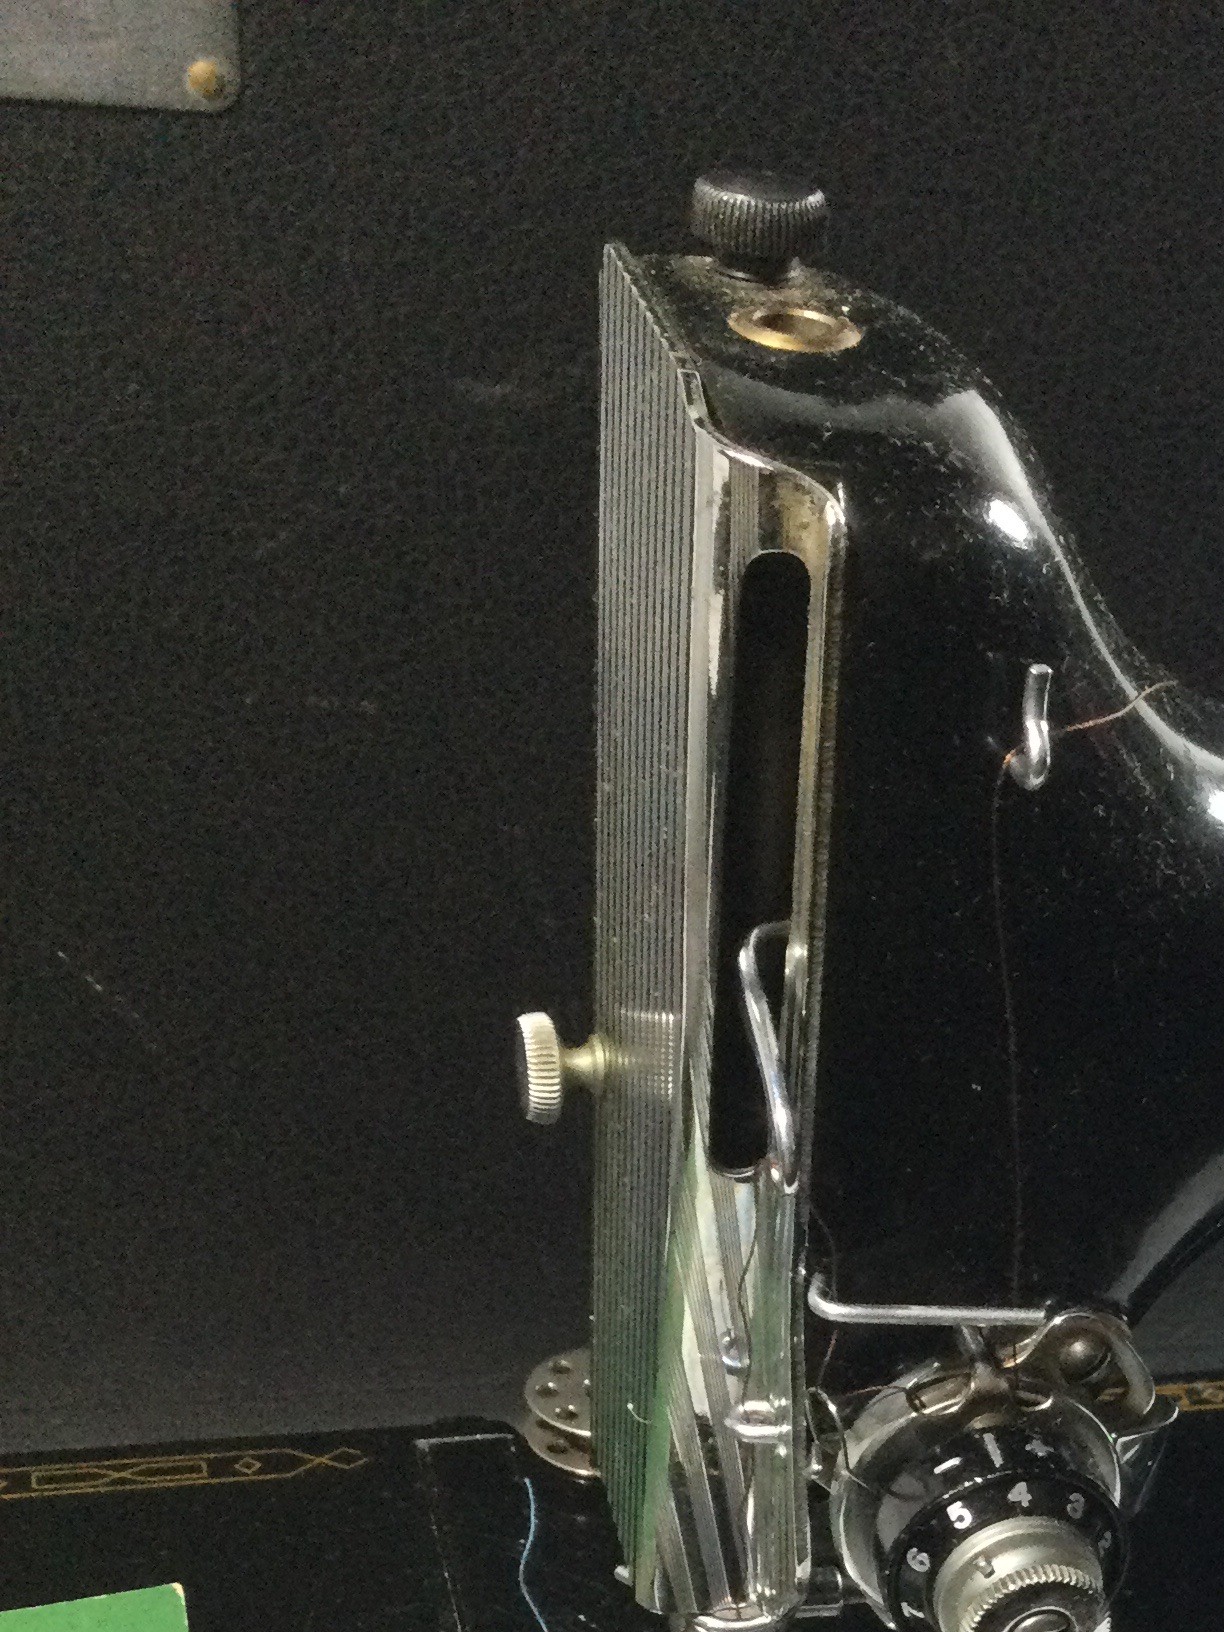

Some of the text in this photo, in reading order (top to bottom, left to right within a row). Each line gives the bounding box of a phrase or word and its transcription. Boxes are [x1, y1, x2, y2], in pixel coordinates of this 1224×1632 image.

[1007, 1481, 1032, 1507] 4
[1066, 1492, 1085, 1519] 3
[946, 1500, 973, 1530] 5
[906, 1547, 930, 1573] 6
